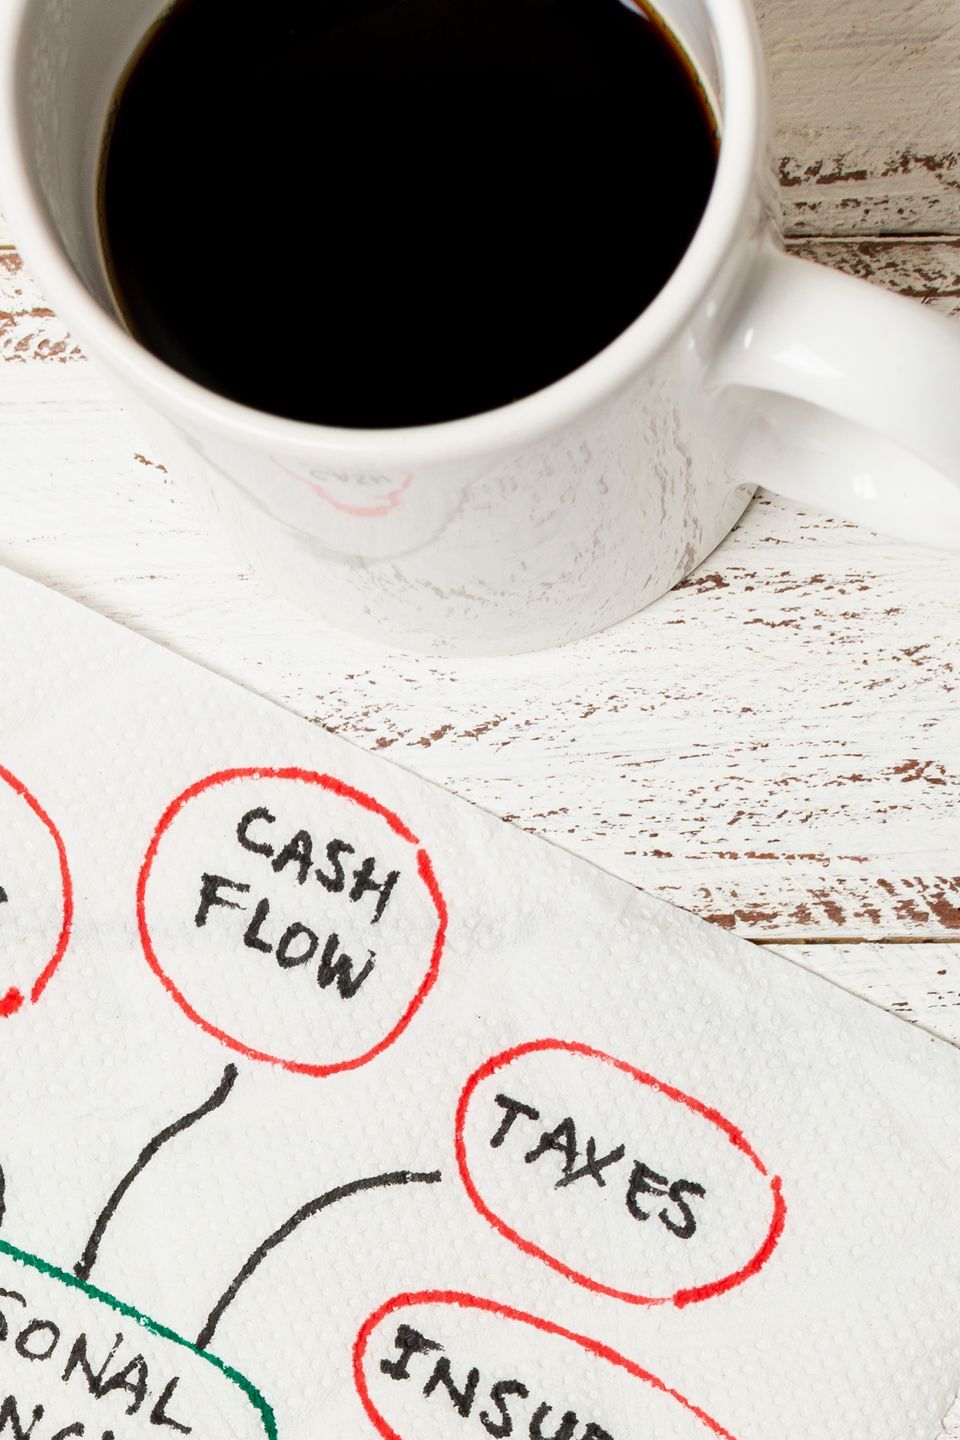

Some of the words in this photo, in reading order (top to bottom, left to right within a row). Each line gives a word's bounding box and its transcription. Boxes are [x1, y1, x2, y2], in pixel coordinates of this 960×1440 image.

[236, 806, 401, 923] CASH
[195, 873, 376, 999] FLOW
[490, 1094, 706, 1239] TAXES
